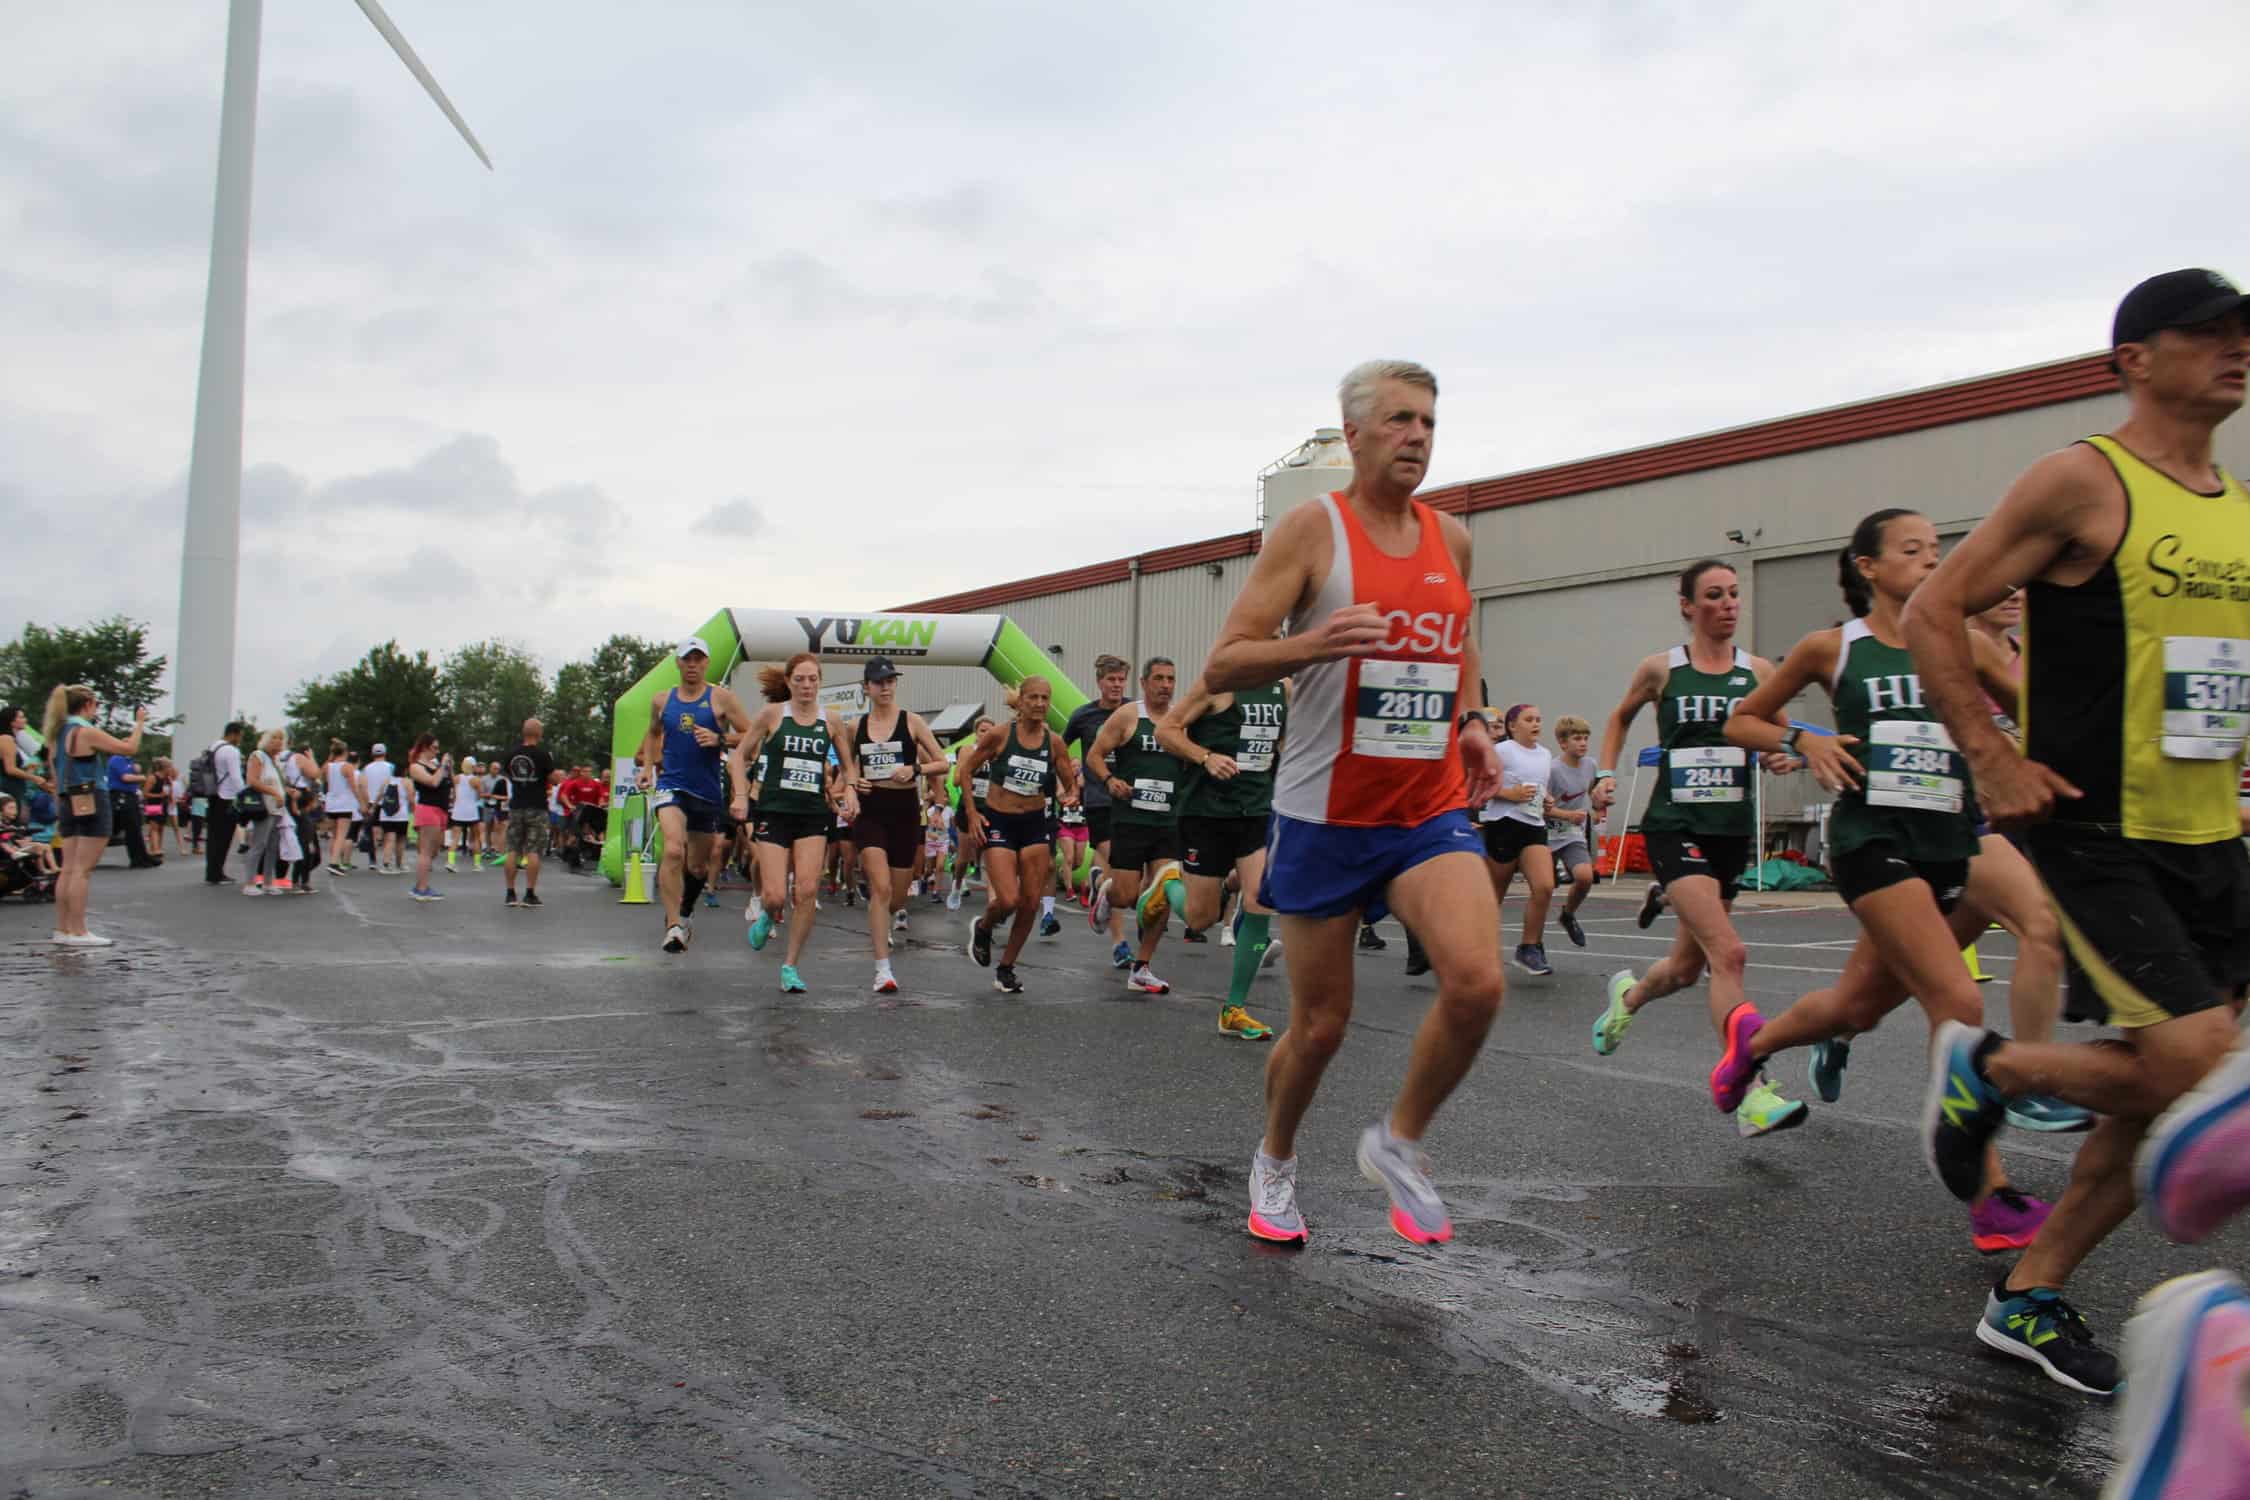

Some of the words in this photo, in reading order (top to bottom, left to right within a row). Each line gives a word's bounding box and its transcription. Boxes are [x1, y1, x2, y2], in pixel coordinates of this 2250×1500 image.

[796, 617, 938, 653] YUKAN
[1376, 610, 1467, 655] CSU
[1376, 691, 1444, 720] 2810
[1863, 674, 1926, 712] HF
[783, 735, 825, 755] HFC
[869, 753, 897, 765] 2706
[1890, 747, 1951, 775] 2384
[788, 769, 816, 783] 2731
[1684, 767, 1734, 787] 2844
